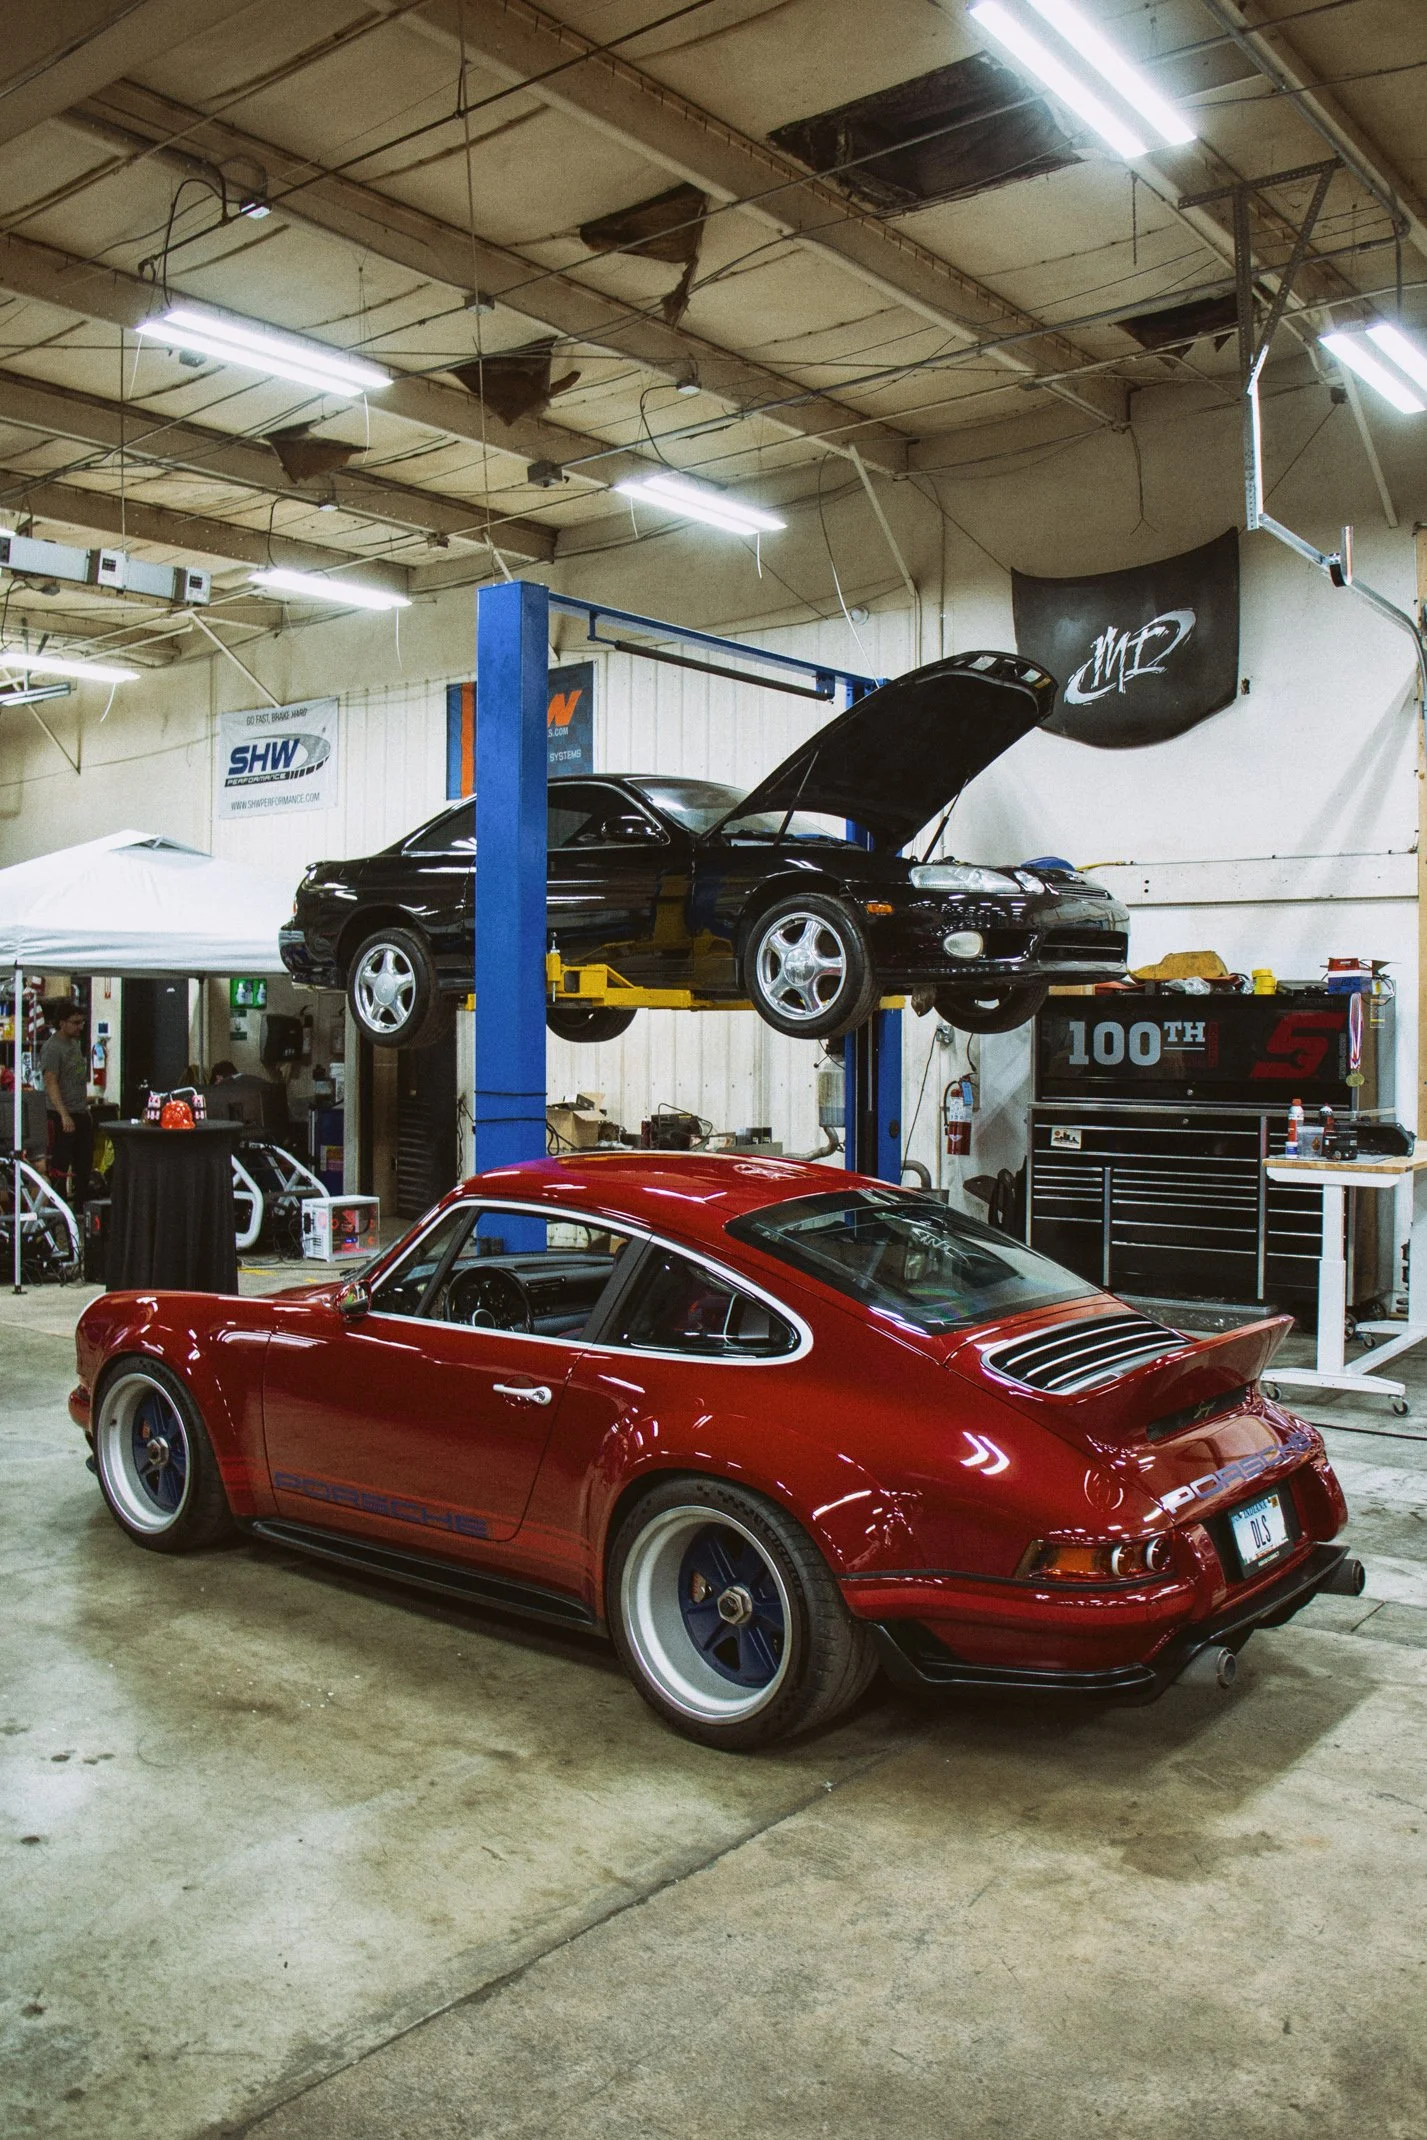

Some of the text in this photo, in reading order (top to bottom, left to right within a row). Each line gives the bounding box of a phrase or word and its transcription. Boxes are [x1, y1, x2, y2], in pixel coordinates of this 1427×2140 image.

[246, 715, 255, 726] GO
[271, 711, 289, 722] BRAKE
[291, 708, 308, 718] HARD
[228, 738, 300, 775] SHW
[549, 749, 582, 762] SYSTEMS
[226, 772, 287, 786] PERFORMANCE
[231, 792, 320, 811] WWW.SHWPERFORMANCE.COM
[1160, 1431, 1313, 1515] PORSCHE
[274, 1471, 489, 1538] PORSCHE
[1250, 1514, 1271, 1548] DLS
